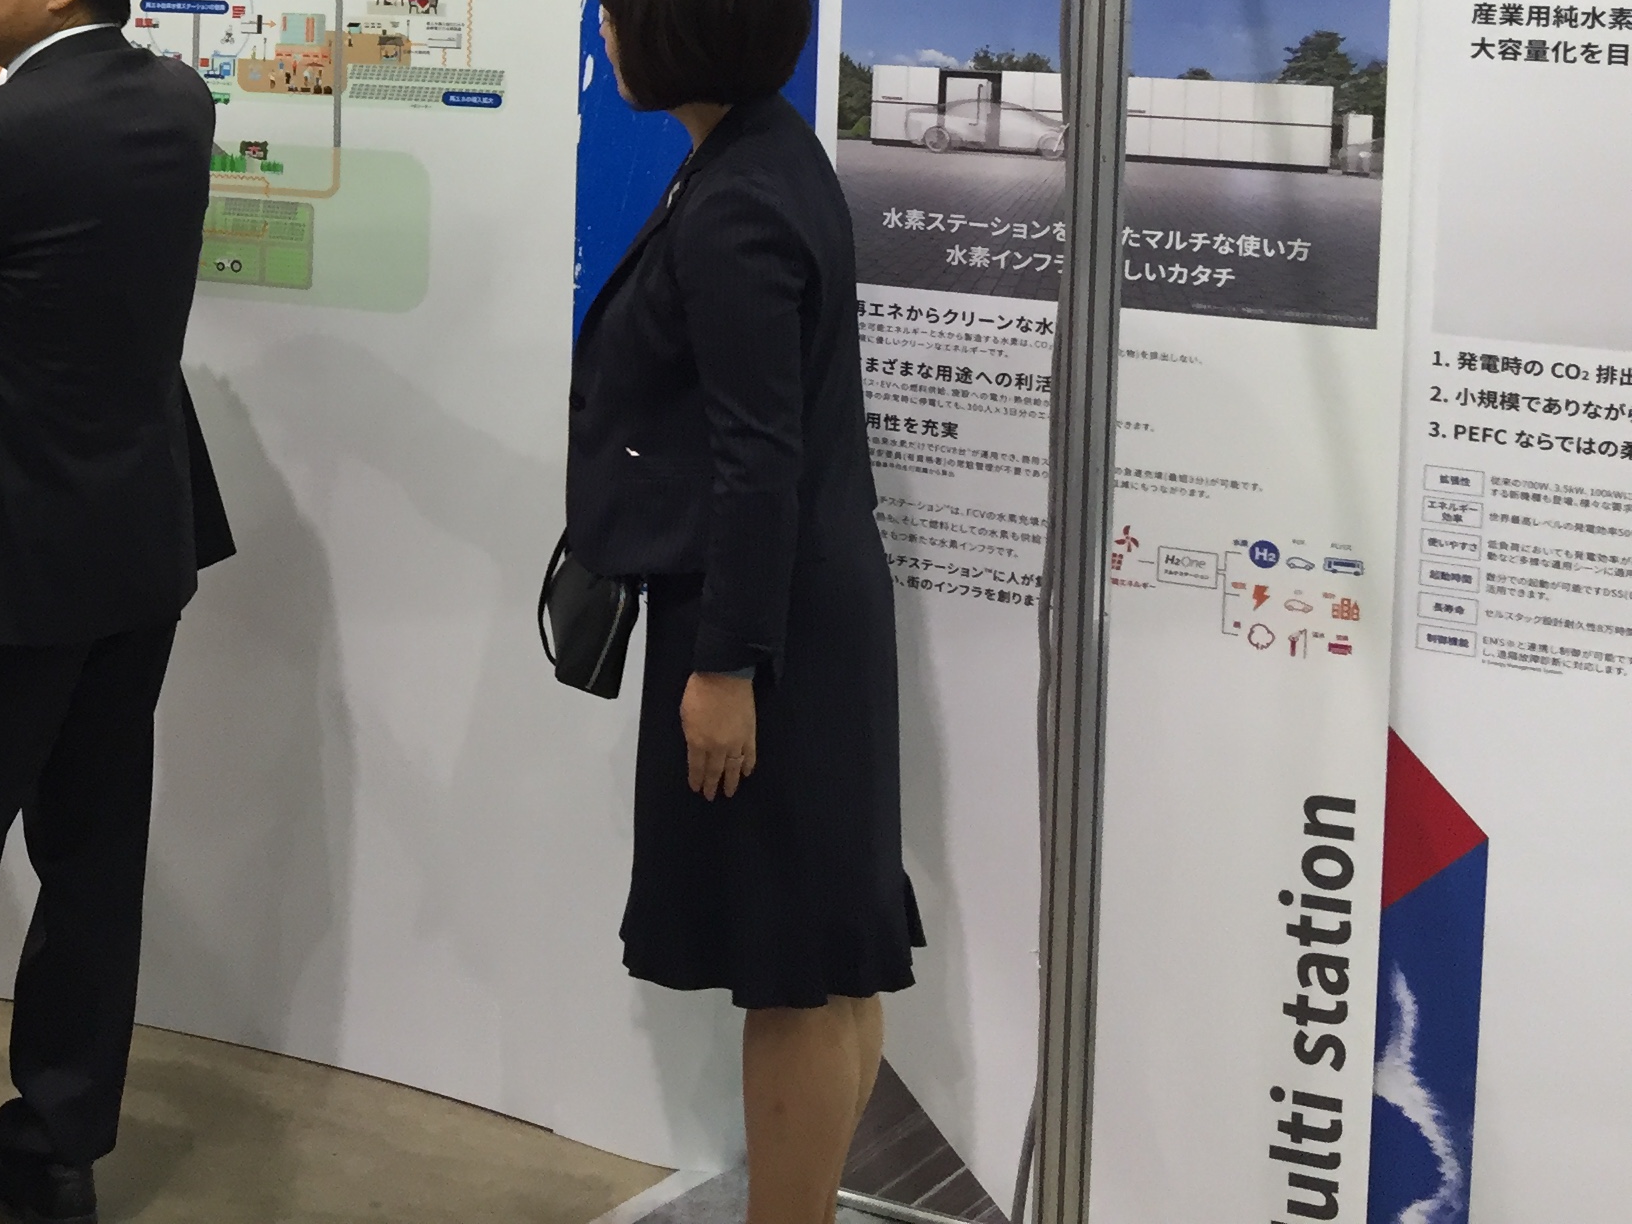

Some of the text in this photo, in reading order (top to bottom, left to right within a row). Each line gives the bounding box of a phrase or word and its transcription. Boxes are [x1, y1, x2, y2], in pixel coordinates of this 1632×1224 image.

[1471, 2, 1632, 30] 産業用純水素
[1470, 37, 1630, 66] 大容量化を目
[1455, 388, 1632, 424] 小規模でありなが
[1453, 425, 1507, 445] PEFC
[1269, 794, 1356, 1224] ulti station
